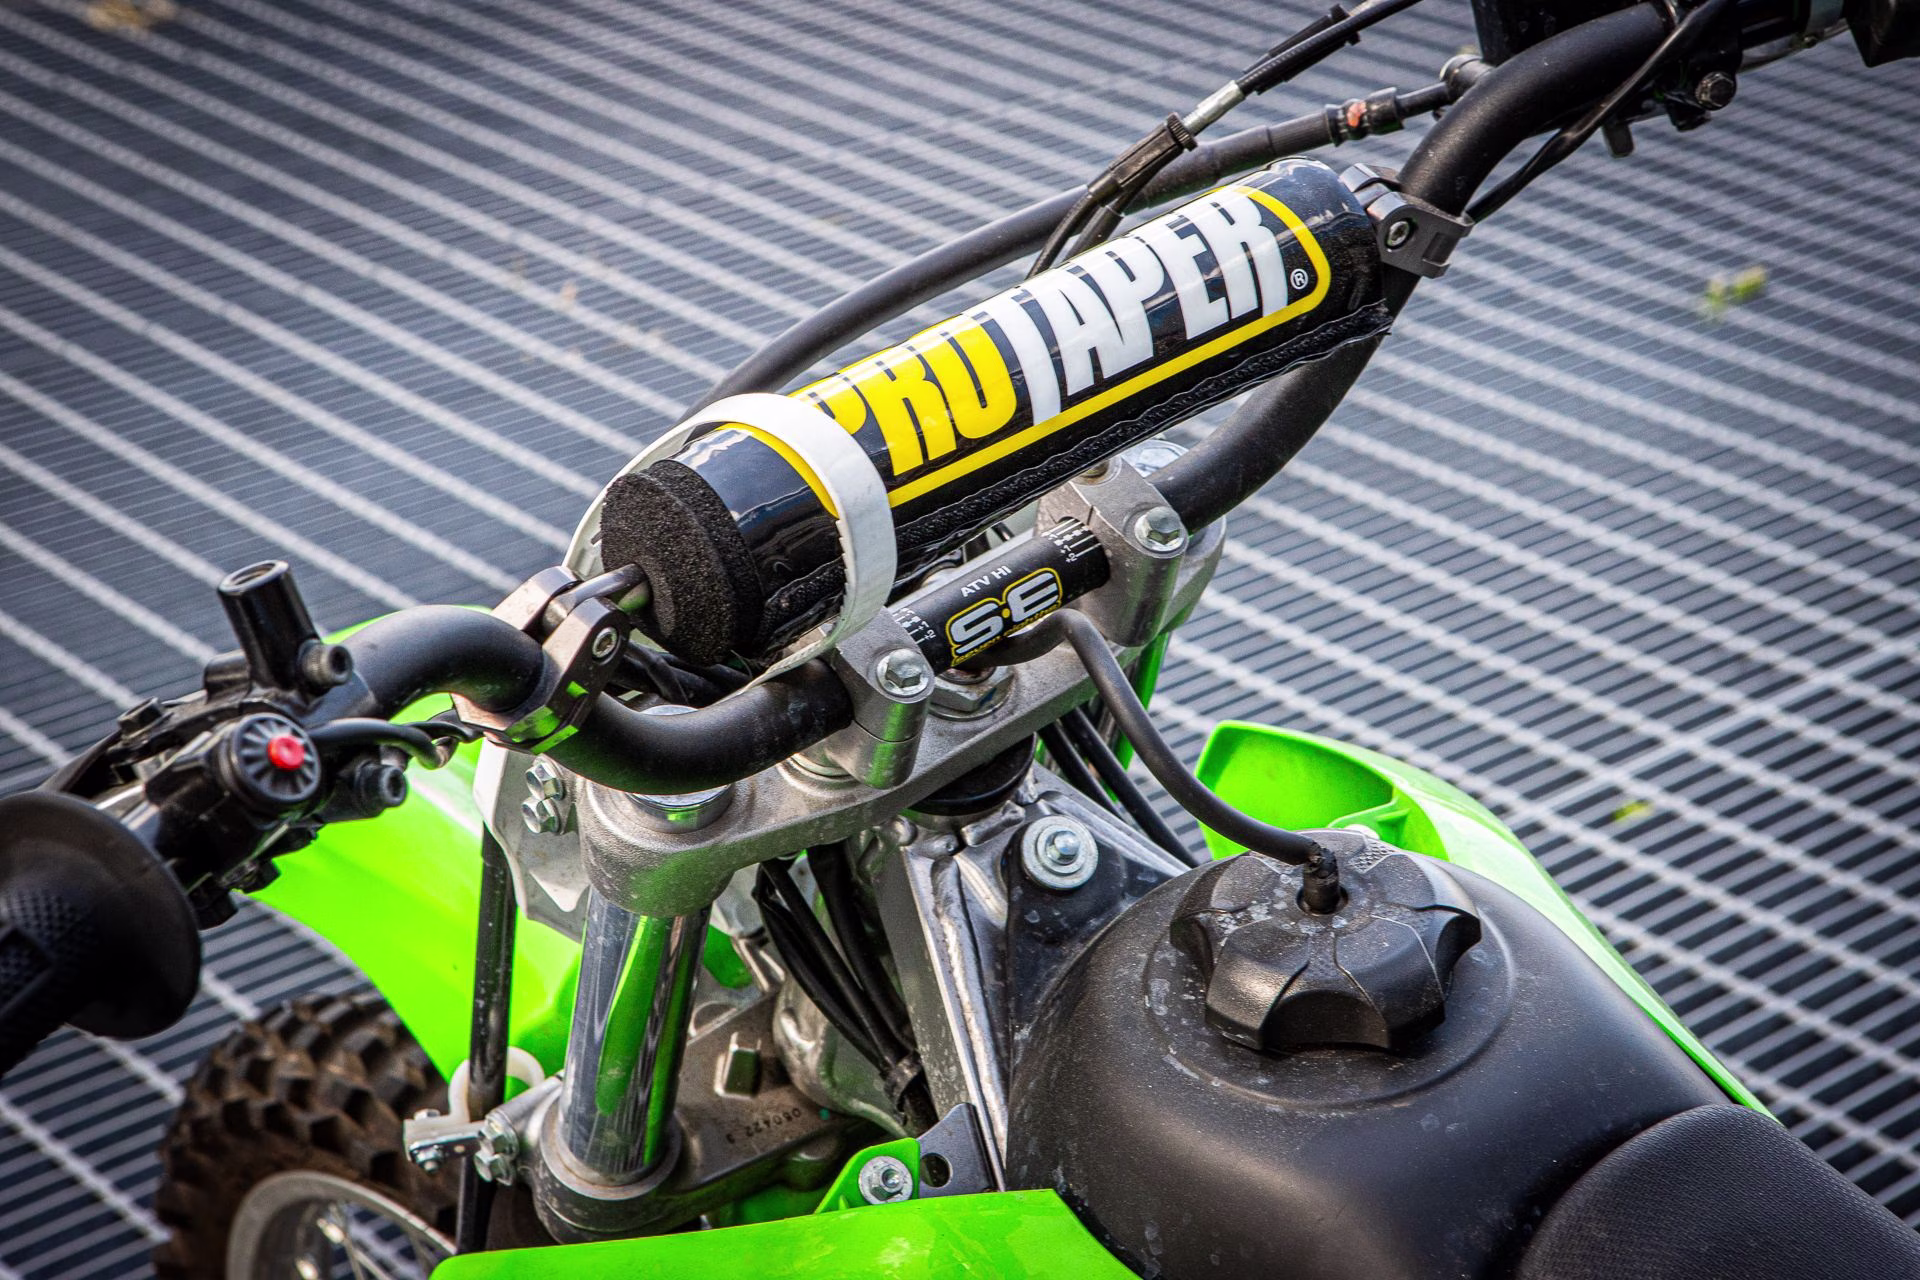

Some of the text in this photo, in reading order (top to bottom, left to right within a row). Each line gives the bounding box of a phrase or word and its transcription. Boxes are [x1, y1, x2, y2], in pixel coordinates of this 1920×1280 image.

[960, 565, 1012, 597] ATV HI
[924, 629, 936, 640] +2
